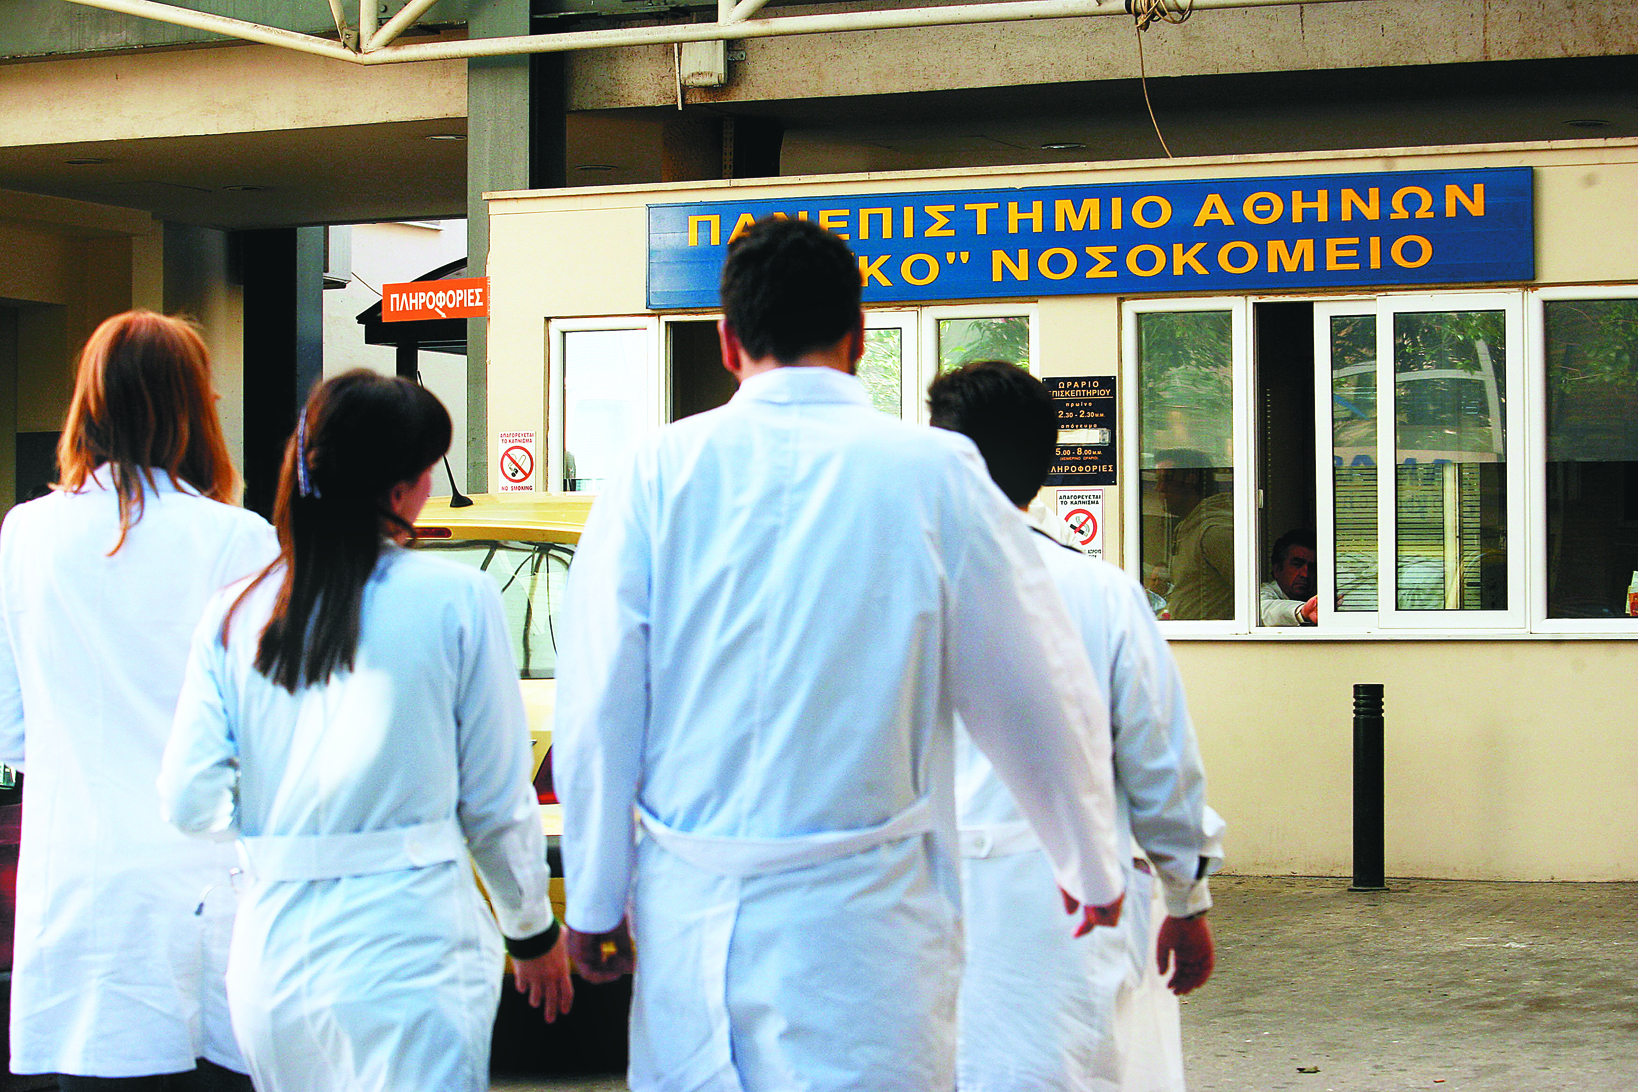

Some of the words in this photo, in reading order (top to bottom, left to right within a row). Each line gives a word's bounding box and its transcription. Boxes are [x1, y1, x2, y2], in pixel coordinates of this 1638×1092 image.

[1193, 183, 1485, 227] ΑΘΗΝΩΝ
[992, 234, 1435, 282] ΝΟΣΟΚΟΜΕΙΟ
[390, 288, 484, 311] ΠΛΗΡΟΦΟΡΙΕΣ
[1048, 389, 1111, 397] ΠΙΣΚΕΠΤΗΡΙΟΥ
[1055, 410, 1074, 418] 2.30
[1055, 447, 1071, 456] 5.00
[1076, 447, 1092, 455] 8.00
[1048, 464, 1114, 473] ΛΗΡΟΦΟΡΙΕΣ
